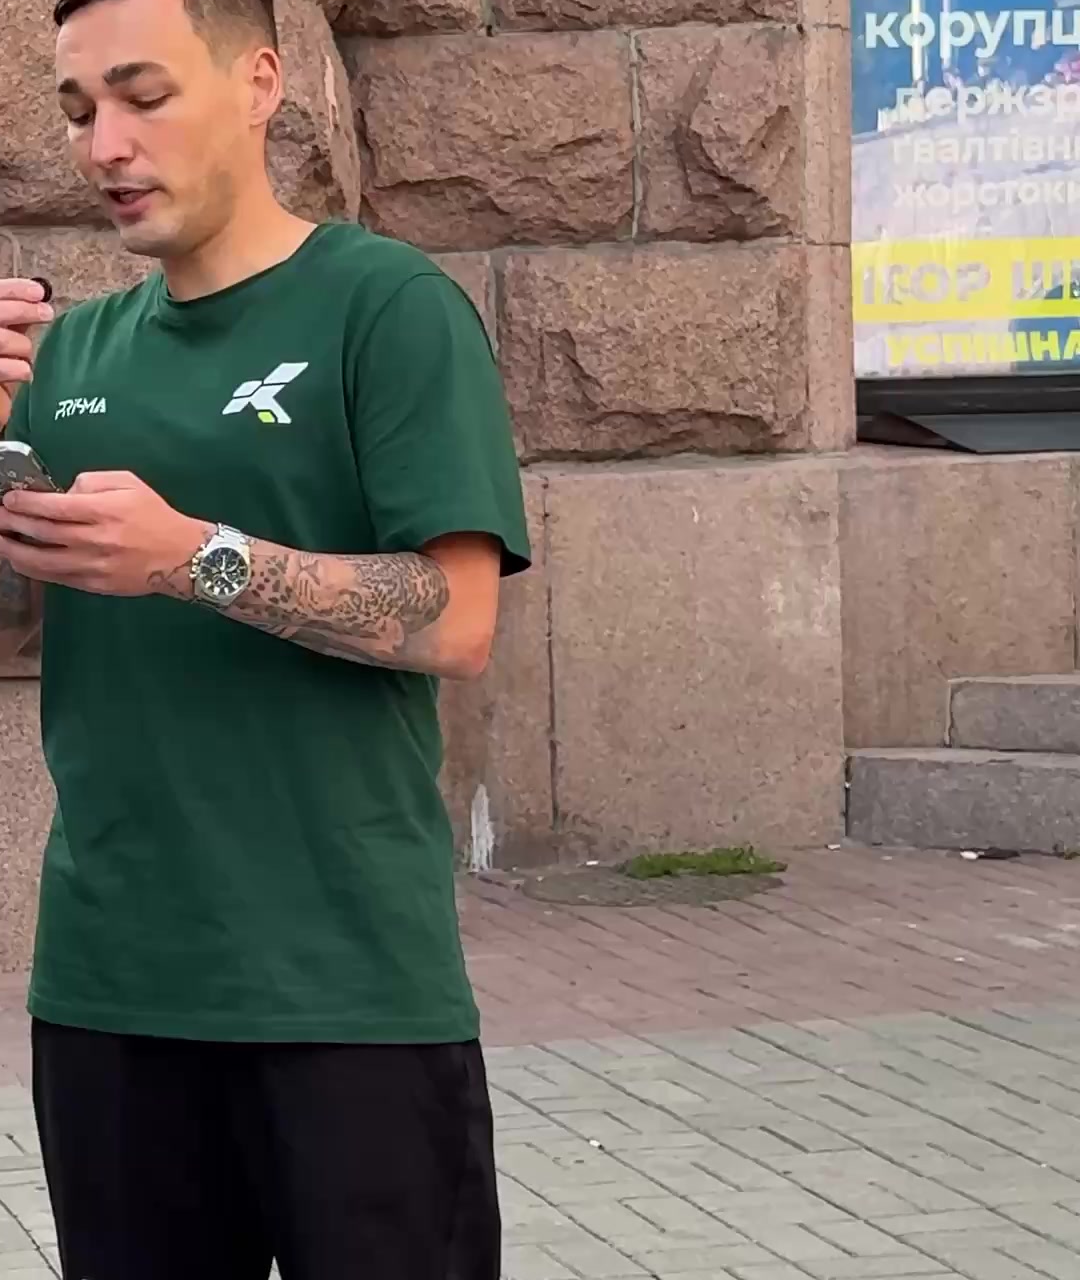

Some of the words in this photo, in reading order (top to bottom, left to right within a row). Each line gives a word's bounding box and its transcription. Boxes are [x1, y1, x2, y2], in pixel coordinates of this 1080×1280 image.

[865, 10, 1080, 60] корупц
[892, 128, 1080, 163] ґвалтівн
[55, 397, 107, 421] PRISMA
